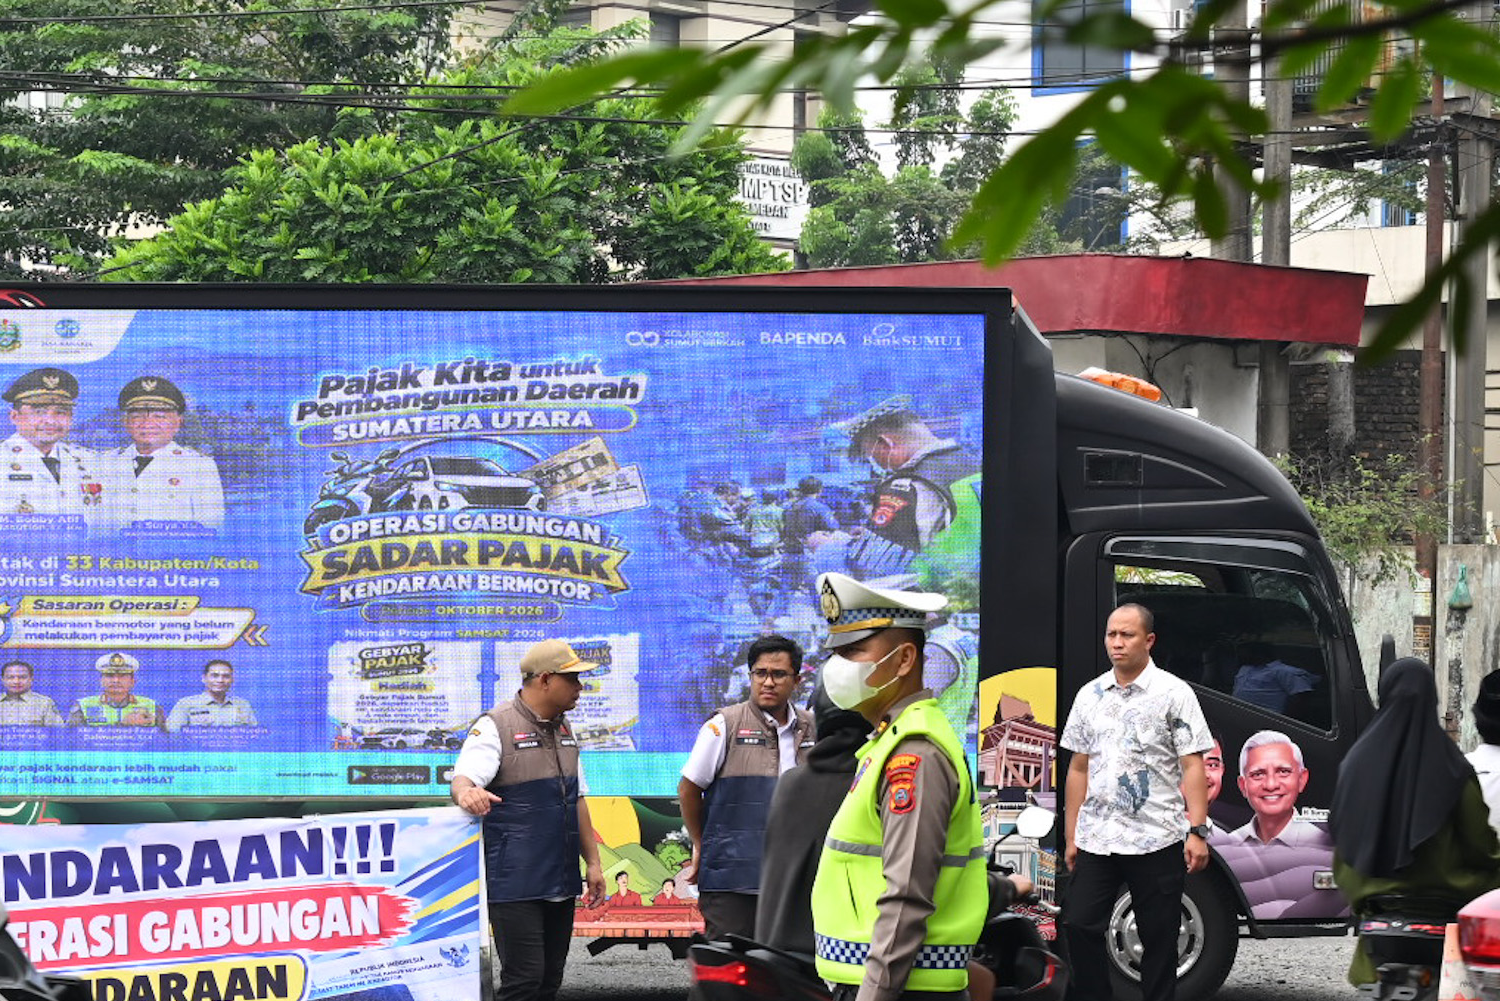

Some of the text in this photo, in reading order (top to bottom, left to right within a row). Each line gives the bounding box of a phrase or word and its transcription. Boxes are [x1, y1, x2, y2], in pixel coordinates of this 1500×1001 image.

[742, 179, 805, 203] MPTSP
[760, 332, 846, 346] BAPENDA
[319, 356, 597, 400] Pajak Kita untuk
[297, 377, 639, 421] Pembangunan Daerah
[333, 409, 594, 442] SUMATERA UTARA
[329, 513, 600, 543] OPERASI GABUNGAN
[41, 556, 58, 570] di
[66, 555, 92, 570] 33
[100, 556, 259, 573] Kabupaten/Kota
[322, 540, 611, 580] SADAR PAJAK
[60, 574, 158, 588] Sumatera
[164, 574, 220, 588] Utara
[339, 574, 591, 602] KENDARAAN BERMOTOR
[33, 600, 105, 611] Sasaran
[109, 600, 177, 614] Operasi
[435, 605, 504, 616] OKTOBER
[23, 619, 234, 632] Kendaraan bermotor yang belum
[25, 632, 218, 643] melakukan pembayaran pajak
[344, 628, 395, 638] Nikmati
[398, 628, 451, 641] Program
[456, 629, 509, 638] SAMSAT
[362, 645, 421, 659] GEBYAR
[365, 654, 421, 669] PAJAK
[19, 763, 52, 775] pajak
[56, 763, 122, 773] kendaraan
[125, 763, 155, 773] lebih
[158, 763, 200, 773] mudah
[32, 776, 78, 785] SIGNAL
[81, 776, 108, 785] atau
[112, 776, 174, 785] e-SAMSAT
[371, 772, 425, 783] Google Play
[8, 911, 128, 968] ERASI
[137, 895, 380, 954] GABUNGAN
